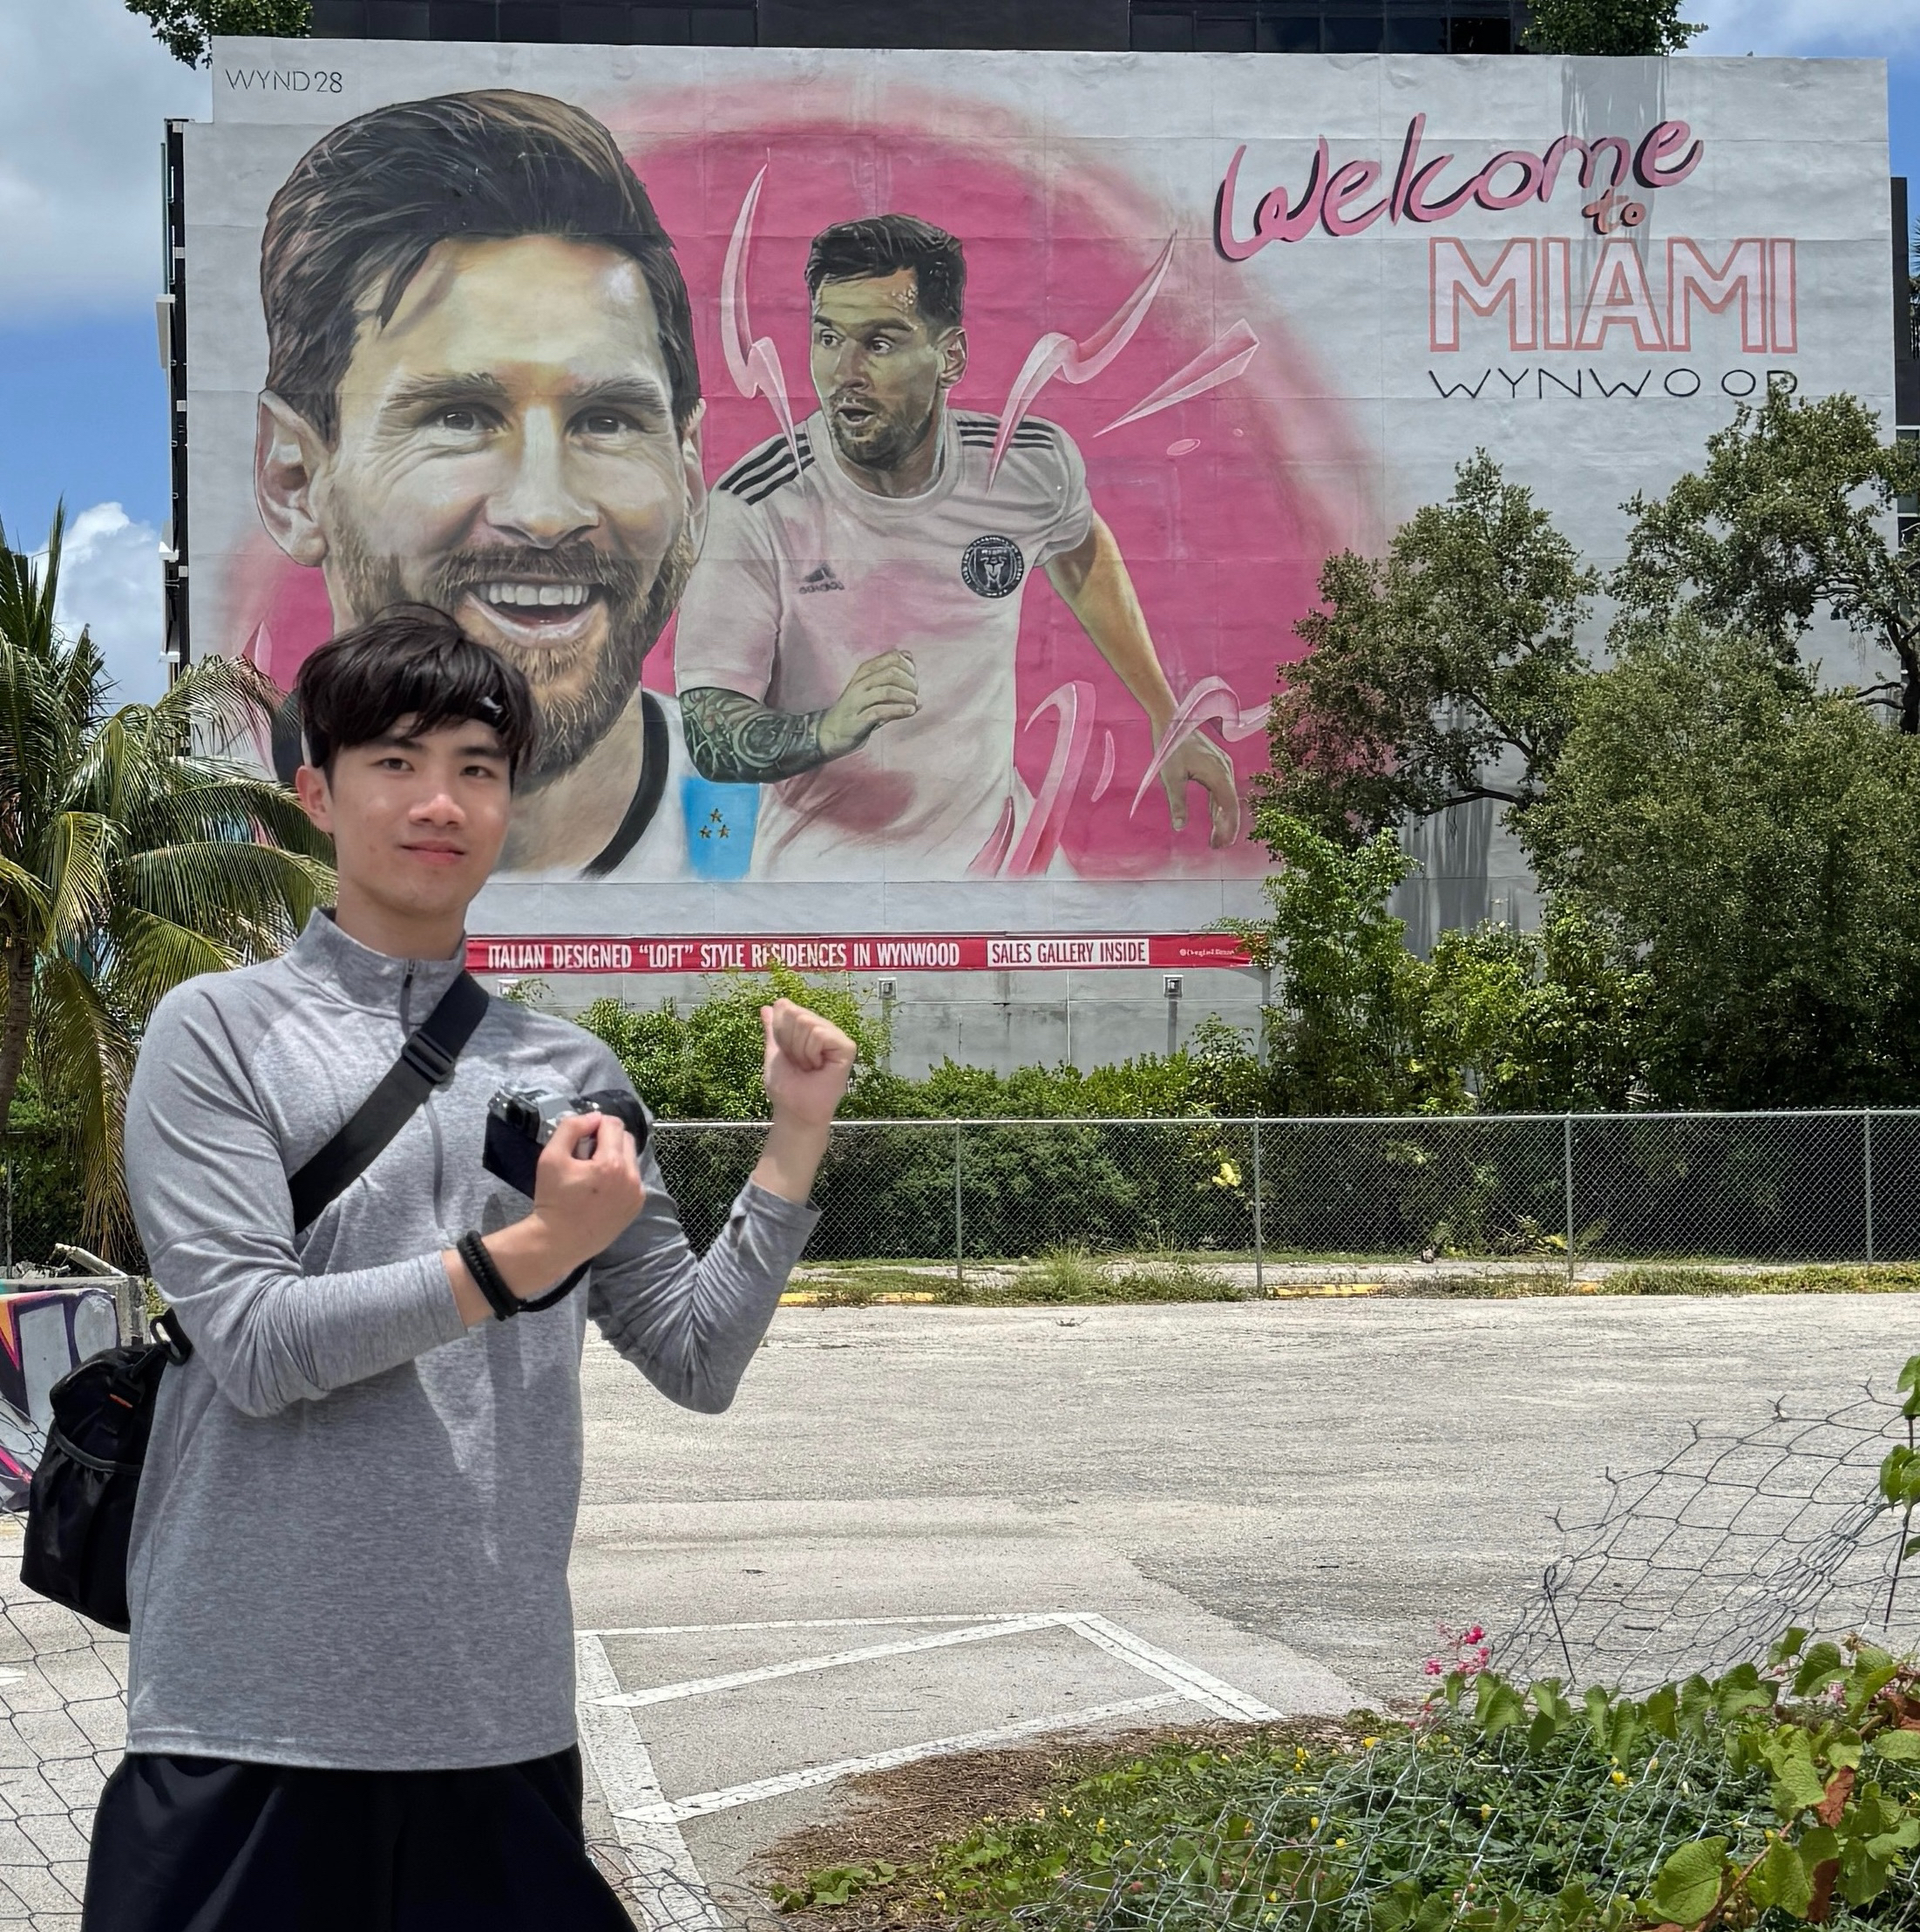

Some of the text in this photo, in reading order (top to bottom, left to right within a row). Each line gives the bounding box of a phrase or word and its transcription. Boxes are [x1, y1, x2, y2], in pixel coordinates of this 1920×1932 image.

[225, 68, 343, 93] WYND28
[1213, 112, 1704, 263] Welcome
[1581, 186, 1646, 235] to
[1428, 236, 1798, 353] MIAMI
[1428, 367, 1798, 398] WYNWOOD
[488, 944, 545, 968] ITALIAN
[553, 944, 632, 968] DESIGNED
[700, 944, 746, 967] STYLE
[751, 943, 847, 967] RESIDENCES
[853, 943, 871, 966] IN
[876, 942, 960, 966] WYNWOOD
[992, 941, 1146, 963] SALES GALLERY INSIDE
